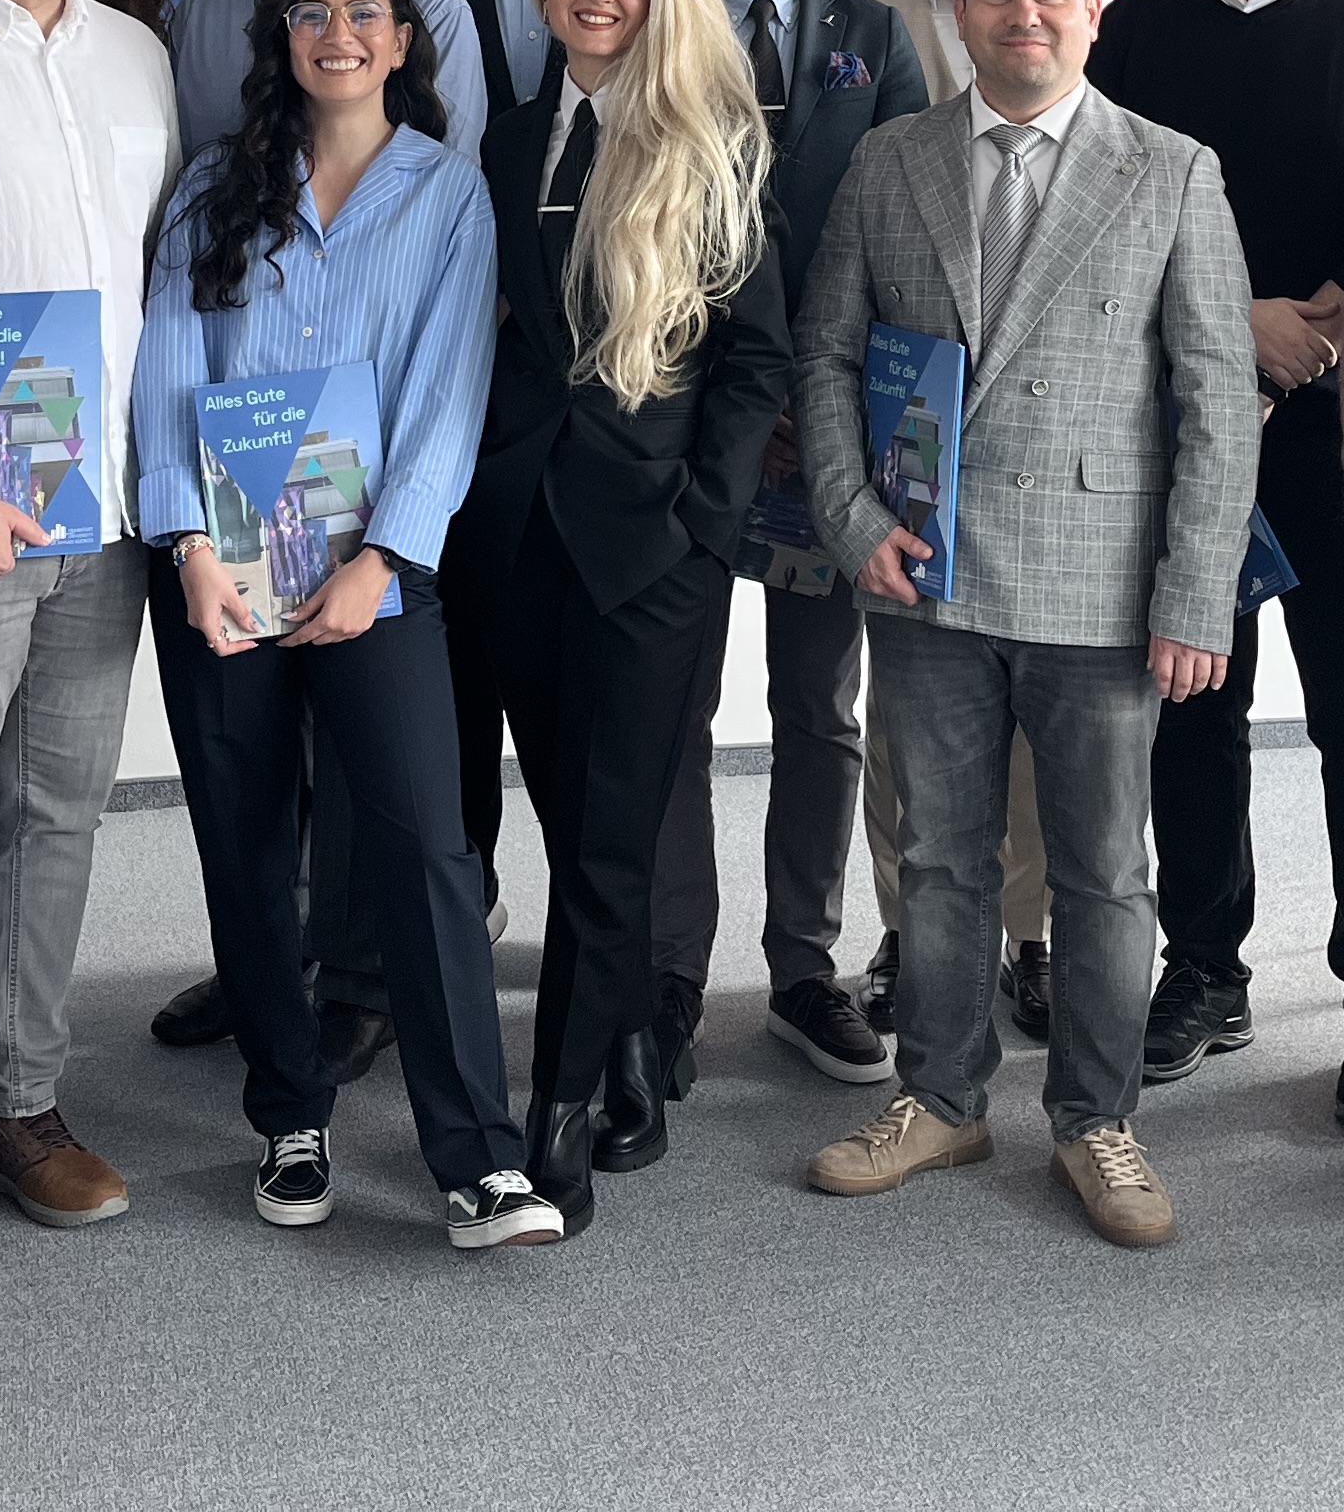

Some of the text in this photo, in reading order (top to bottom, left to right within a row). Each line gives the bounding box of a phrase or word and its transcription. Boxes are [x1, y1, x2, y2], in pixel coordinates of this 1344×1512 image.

[205, 388, 286, 412] Alles Gute
[252, 406, 306, 426] für die
[222, 430, 292, 454] Zukunft!
